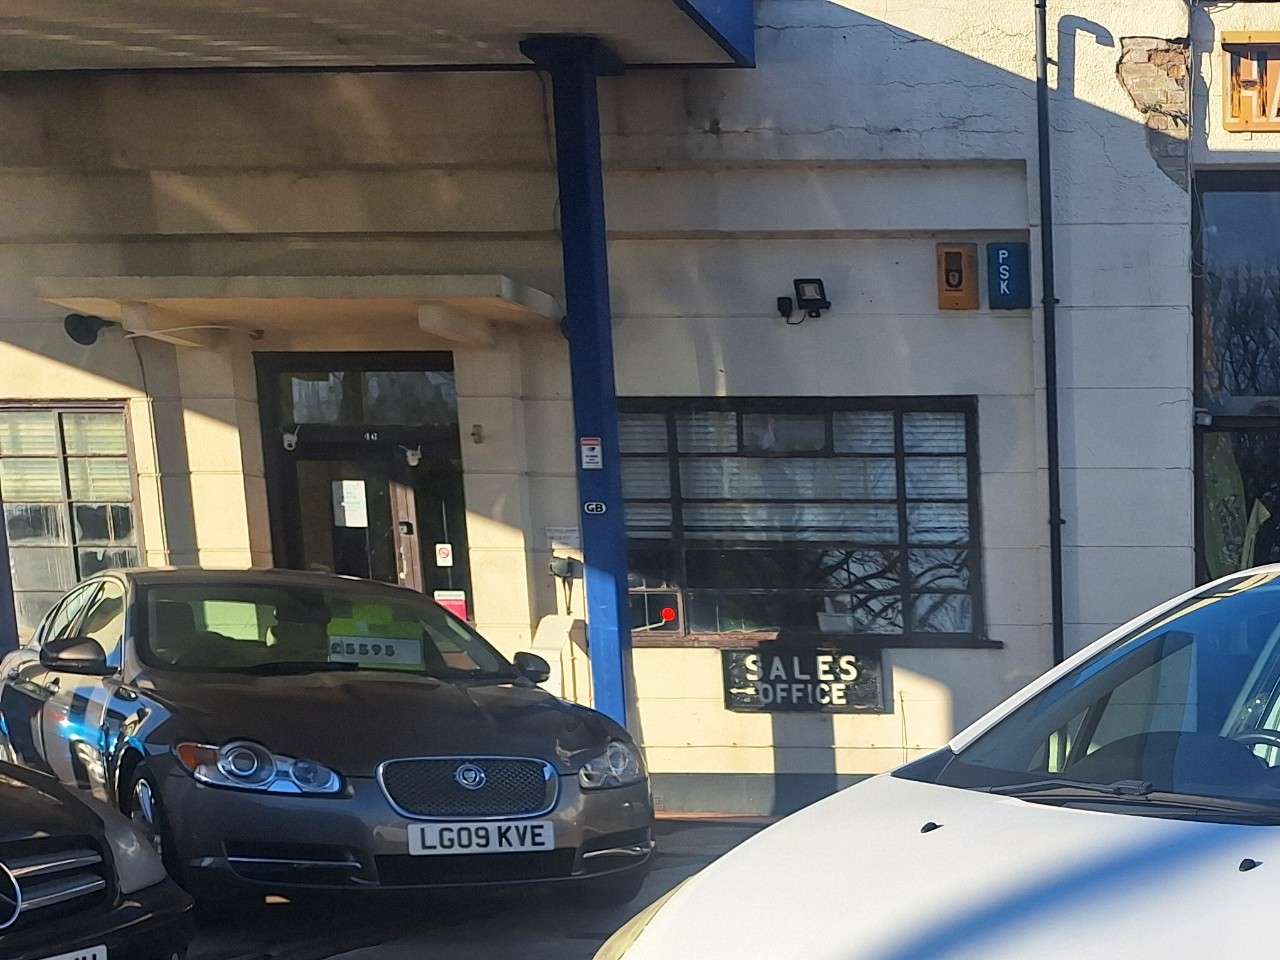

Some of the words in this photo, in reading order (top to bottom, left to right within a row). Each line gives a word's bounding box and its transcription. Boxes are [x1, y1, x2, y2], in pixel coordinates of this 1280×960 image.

[998, 249, 1010, 295] PSK
[586, 503, 604, 512] GB
[744, 654, 858, 682] SALES
[759, 683, 847, 705] OFFICE
[420, 826, 490, 850] LG09
[497, 824, 546, 848] KVE
